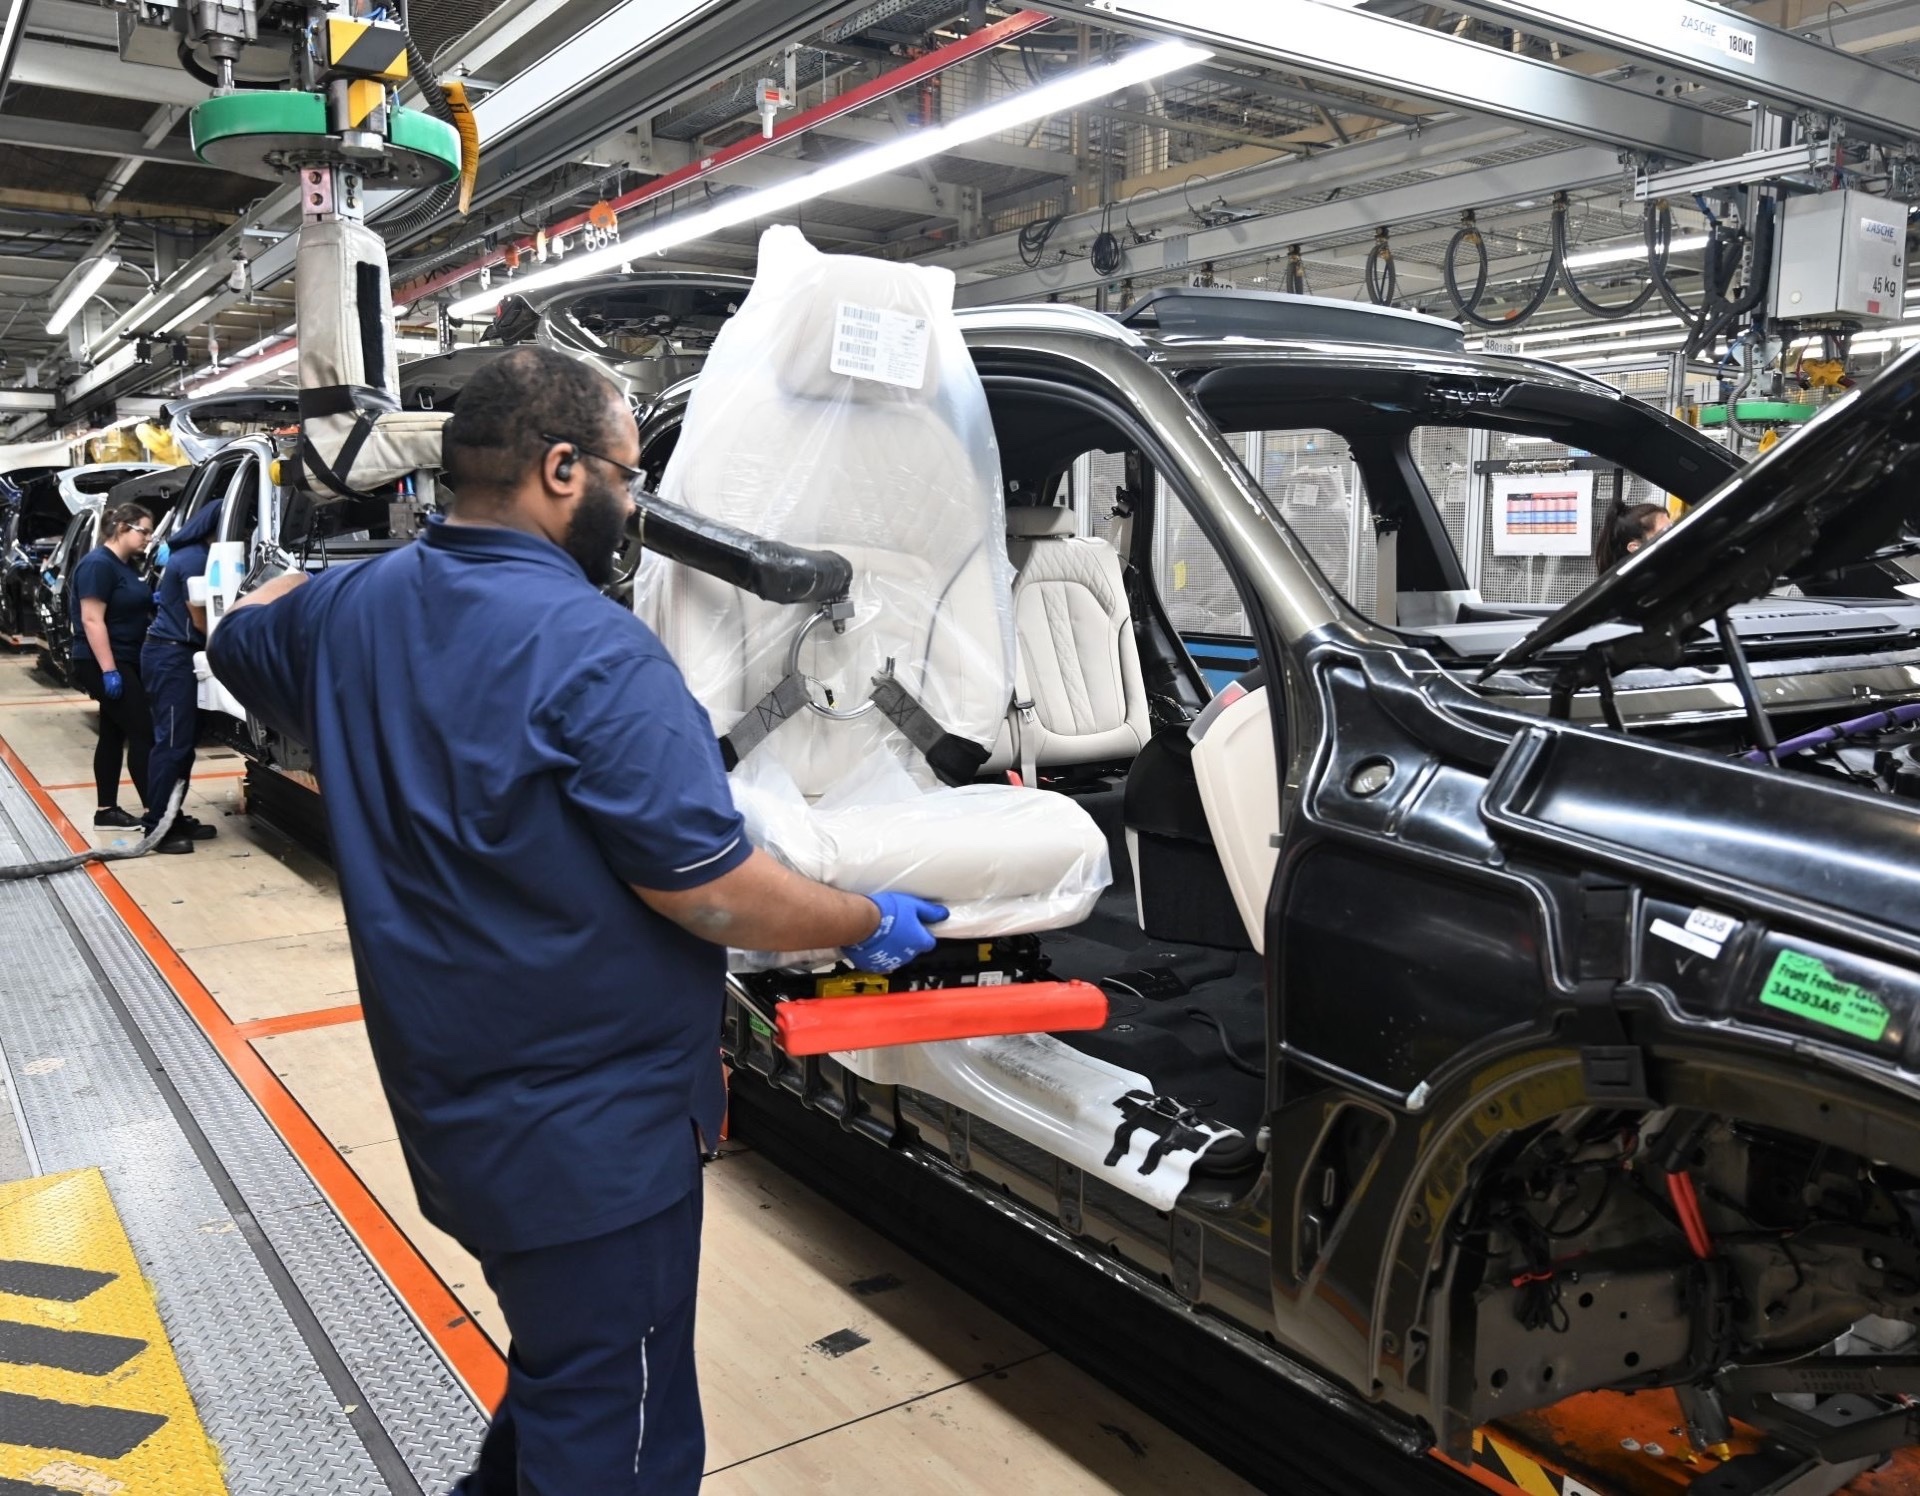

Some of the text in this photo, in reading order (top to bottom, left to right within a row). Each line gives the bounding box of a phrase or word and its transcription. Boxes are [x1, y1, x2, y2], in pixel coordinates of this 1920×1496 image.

[1681, 16, 1717, 37] ZASCHE
[1729, 35, 1753, 56] 180KG
[1866, 222, 1895, 238] ZASCHE
[1872, 275, 1896, 298] 45 kg
[1769, 981, 1842, 1015] 3A293A6
